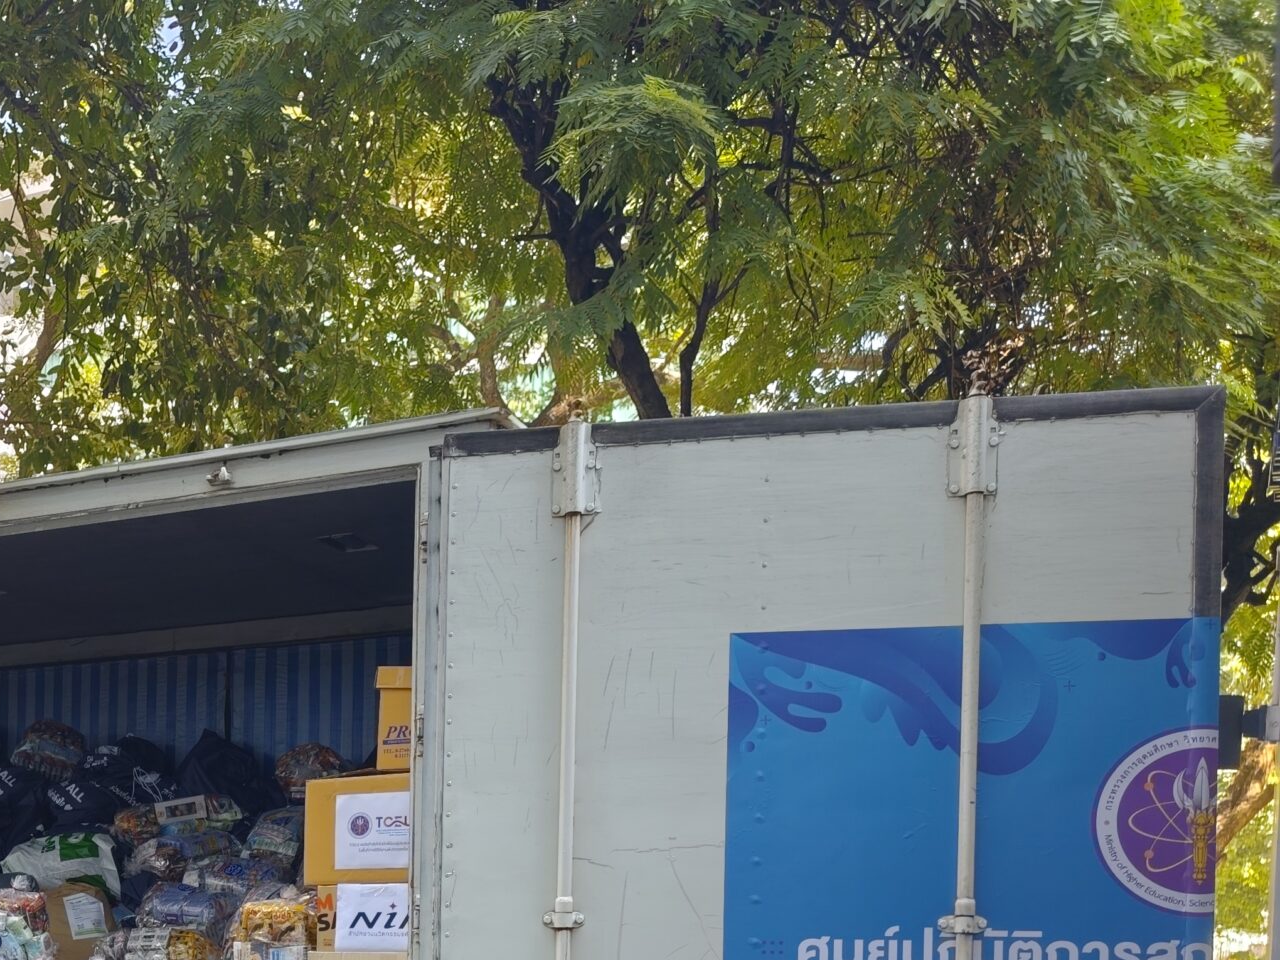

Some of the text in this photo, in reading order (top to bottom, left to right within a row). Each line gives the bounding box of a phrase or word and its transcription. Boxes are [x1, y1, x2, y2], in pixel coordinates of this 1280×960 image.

[375, 815, 410, 829] TCEL
[1104, 834, 1120, 862] Ministry
[1117, 862, 1127, 872] of
[1123, 869, 1144, 890] Higher
[1144, 886, 1186, 906] Education,
